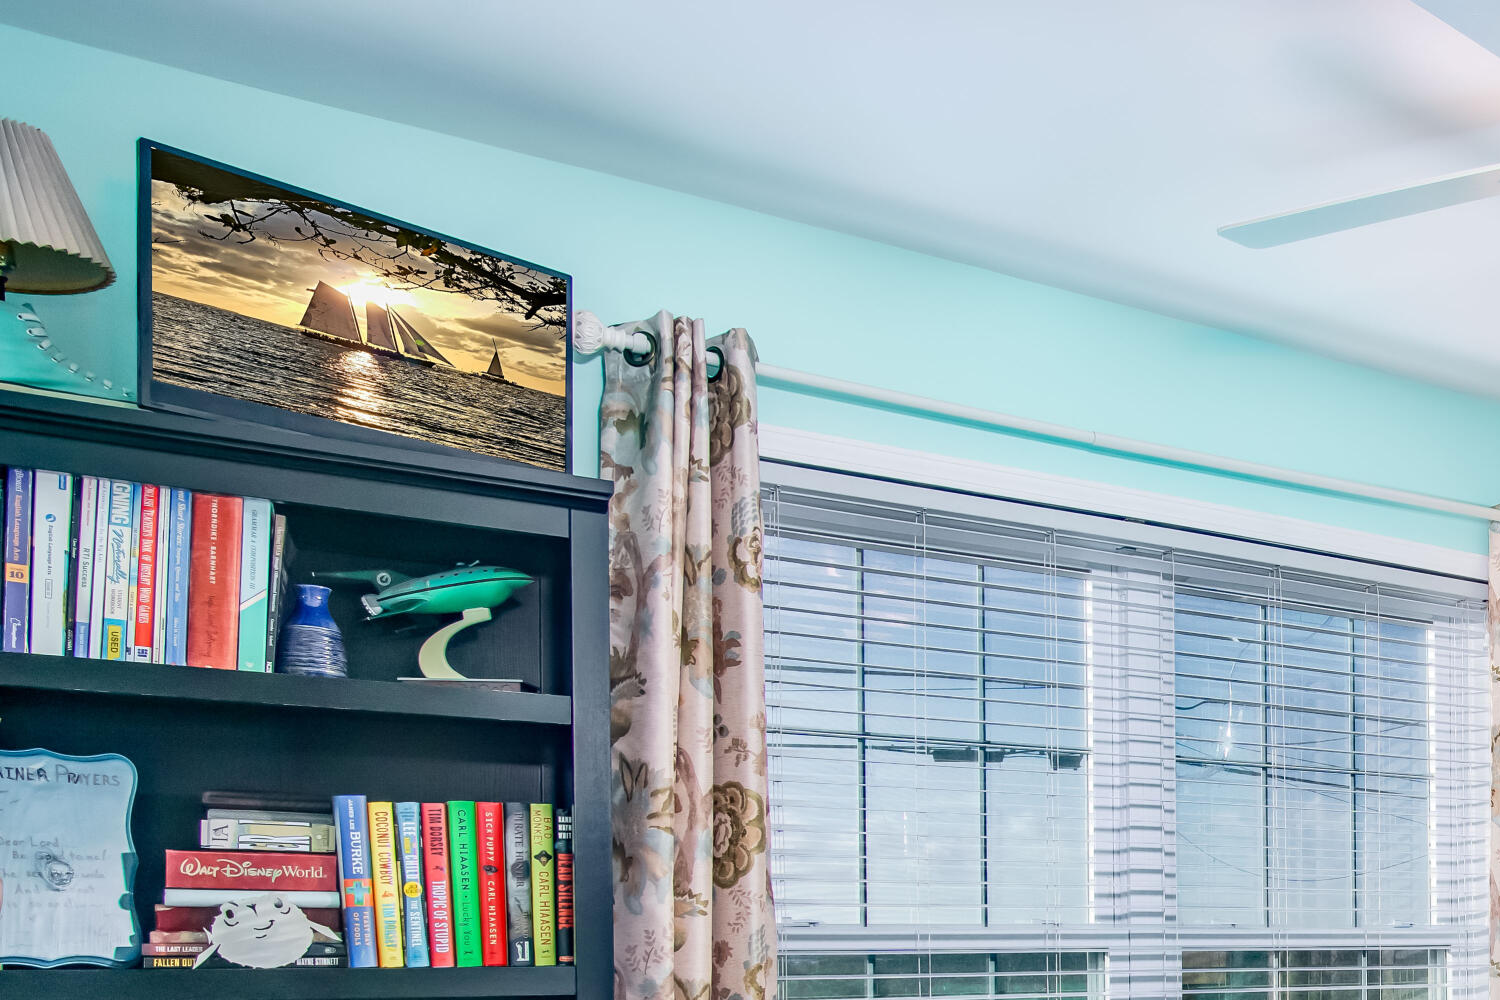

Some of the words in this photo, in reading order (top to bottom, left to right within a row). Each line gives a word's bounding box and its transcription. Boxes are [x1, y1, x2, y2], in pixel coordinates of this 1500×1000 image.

[177, 504, 186, 521] Short
[210, 498, 218, 540] THORNDIKE
[107, 528, 128, 584] Naturally
[142, 539, 154, 552] BOOK
[81, 561, 89, 587] Success
[209, 546, 217, 582] BARNHART
[140, 587, 152, 603] WORD
[138, 605, 151, 624] GAMES
[110, 631, 118, 653] USED
[56, 764, 120, 786] PRAYERS
[375, 811, 391, 848] COCONUT
[403, 822, 416, 836] LEE
[429, 809, 441, 824] TIM
[458, 810, 468, 837] CARL
[485, 812, 493, 834] SICK
[532, 810, 543, 846] MONKEY
[544, 818, 552, 840] BAD
[430, 826, 443, 856] DORSEY
[514, 812, 525, 848] PIRATE
[350, 832, 364, 874] BURKE
[486, 836, 494, 861] PUPPY
[282, 866, 324, 878] World
[378, 852, 392, 886] COWBOY
[405, 854, 418, 880] CHILD
[460, 844, 470, 890] HIAASEN
[558, 853, 574, 881] DEAD
[432, 880, 447, 908] TROPIC
[488, 880, 496, 902] CARL
[539, 872, 550, 897] CARL
[353, 912, 359, 921] OF
[382, 903, 396, 918] TIM
[434, 911, 448, 919] OF
[460, 902, 470, 926] Lucky
[558, 884, 574, 930] SILENCE
[384, 920, 398, 948] DORSEY
[410, 912, 422, 948] SENTINEL
[488, 906, 497, 945] HIAASEN
[540, 901, 551, 946] HIAASEN
[434, 922, 450, 953] STUPID
[463, 931, 472, 946] You
[154, 958, 180, 967] FALLEN
